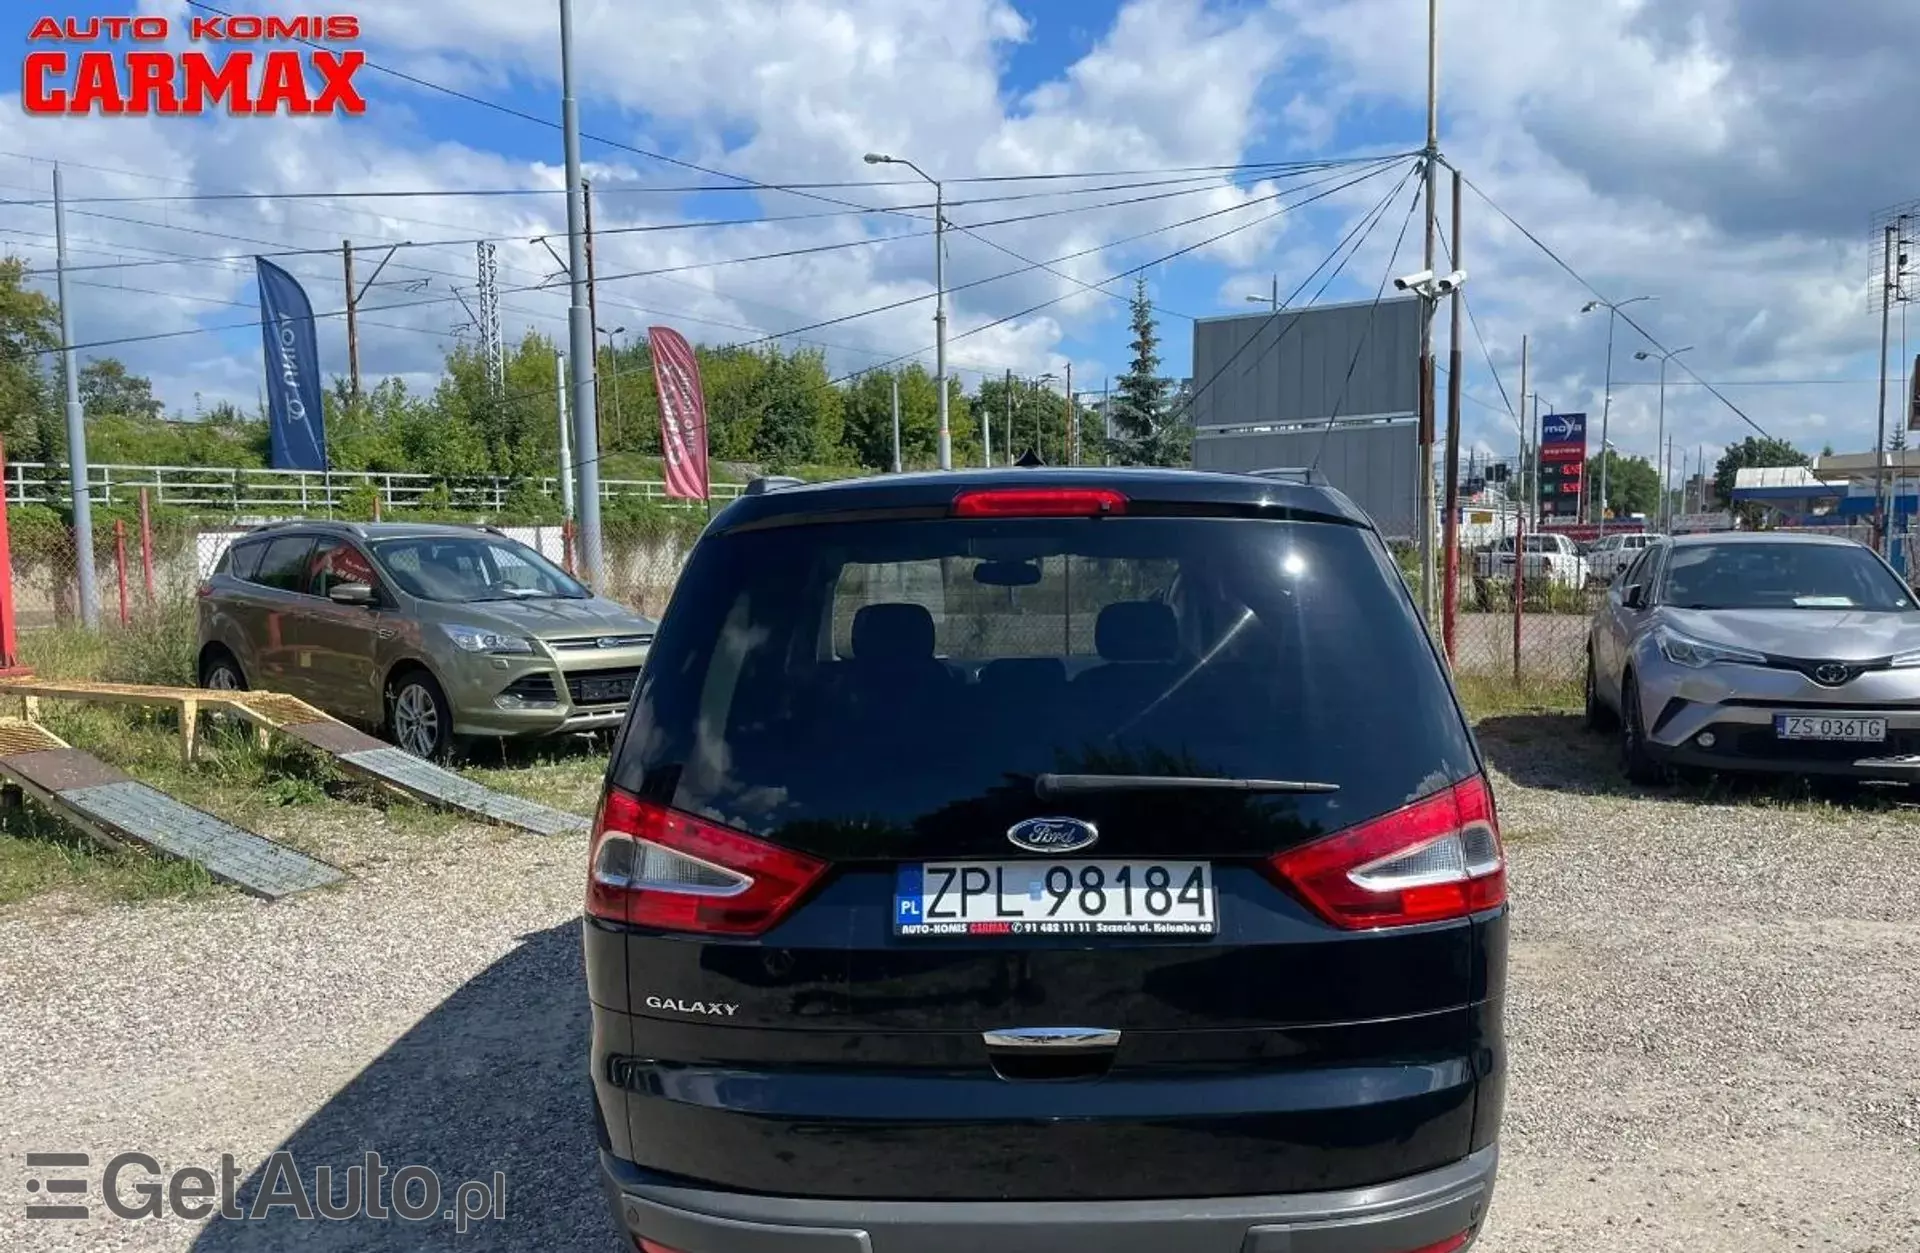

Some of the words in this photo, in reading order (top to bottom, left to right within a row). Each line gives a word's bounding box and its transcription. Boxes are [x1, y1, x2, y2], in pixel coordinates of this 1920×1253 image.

[1789, 718, 1813, 736] ZS
[1820, 719, 1881, 737] 036TG
[1028, 822, 1076, 844] Ford
[926, 867, 1024, 918] ZPL
[1045, 865, 1206, 917] 98184
[901, 901, 920, 915] PL
[646, 996, 739, 1016] GALAXY
